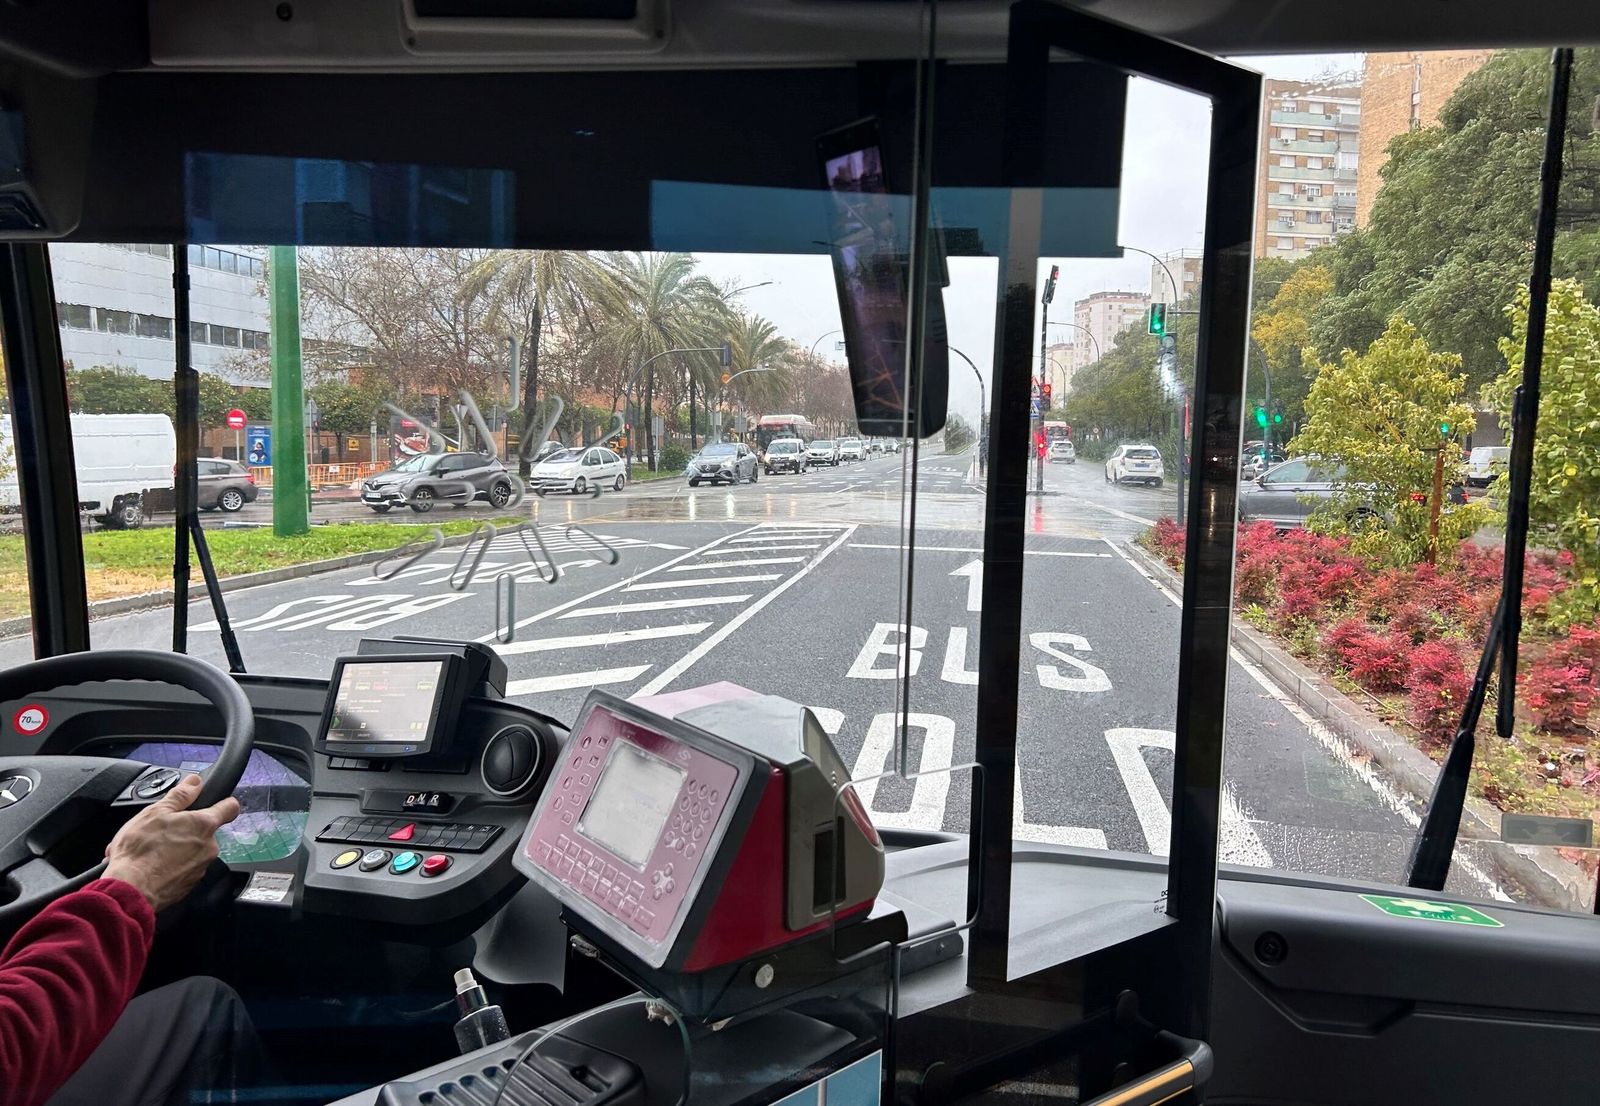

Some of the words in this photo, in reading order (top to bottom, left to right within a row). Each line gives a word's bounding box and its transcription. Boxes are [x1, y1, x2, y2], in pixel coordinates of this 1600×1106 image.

[187, 593, 471, 631] BUS
[21, 716, 32, 724] 70
[406, 794, 415, 804] D
[418, 793, 427, 802] N
[431, 794, 440, 803] R
